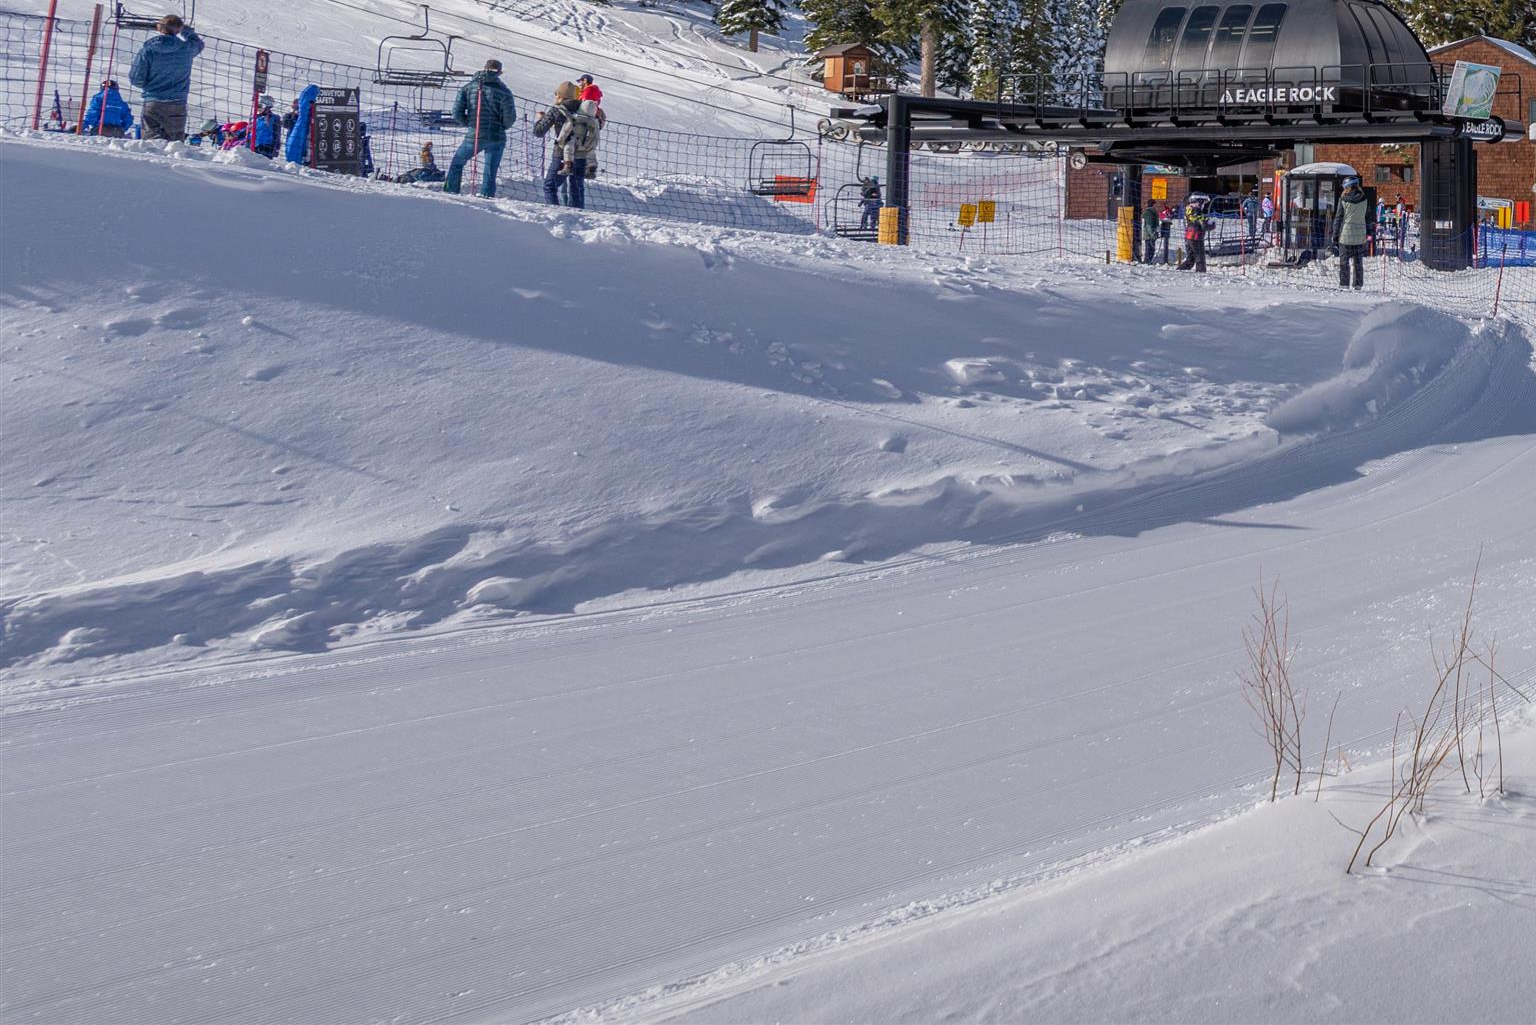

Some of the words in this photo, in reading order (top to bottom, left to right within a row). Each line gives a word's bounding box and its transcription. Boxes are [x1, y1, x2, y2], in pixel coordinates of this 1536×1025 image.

[319, 89, 346, 97] ONVEYOR
[1236, 88, 1286, 103] EAGLE
[1289, 86, 1336, 102] ROCK
